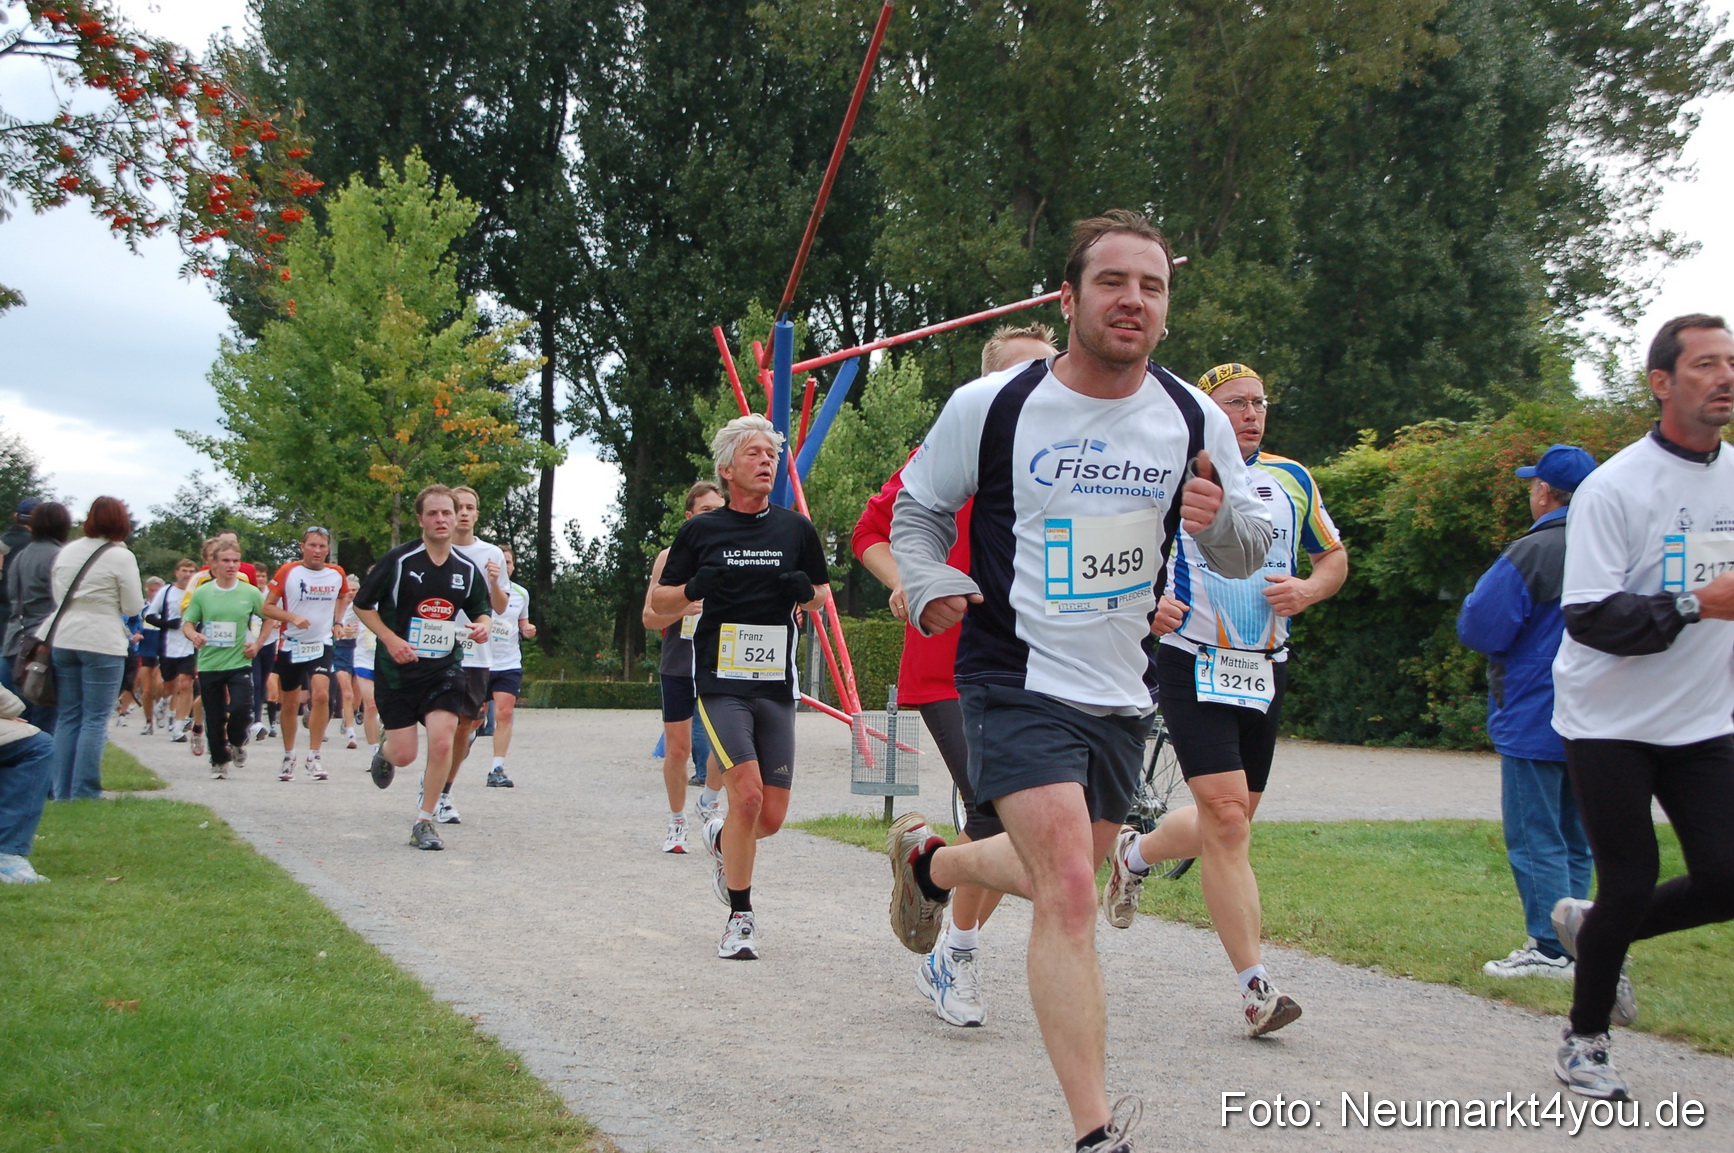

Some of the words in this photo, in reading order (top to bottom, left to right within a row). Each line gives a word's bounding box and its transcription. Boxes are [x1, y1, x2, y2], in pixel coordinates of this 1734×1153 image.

[1054, 458, 1172, 484] Fischer
[1070, 483, 1165, 499] Automobile
[723, 550, 741, 558] LLC
[742, 549, 783, 557] Marathon
[727, 558, 780, 567] Regensburg
[1082, 547, 1144, 580] 3459
[213, 631, 233, 639] 2434
[492, 626, 509, 636] 2804
[738, 629, 763, 641] Franz
[423, 633, 449, 646] 2841
[301, 645, 321, 653] 2780
[744, 647, 776, 662] 524
[1220, 655, 1259, 670] Matthias
[1220, 673, 1266, 692] 3216
